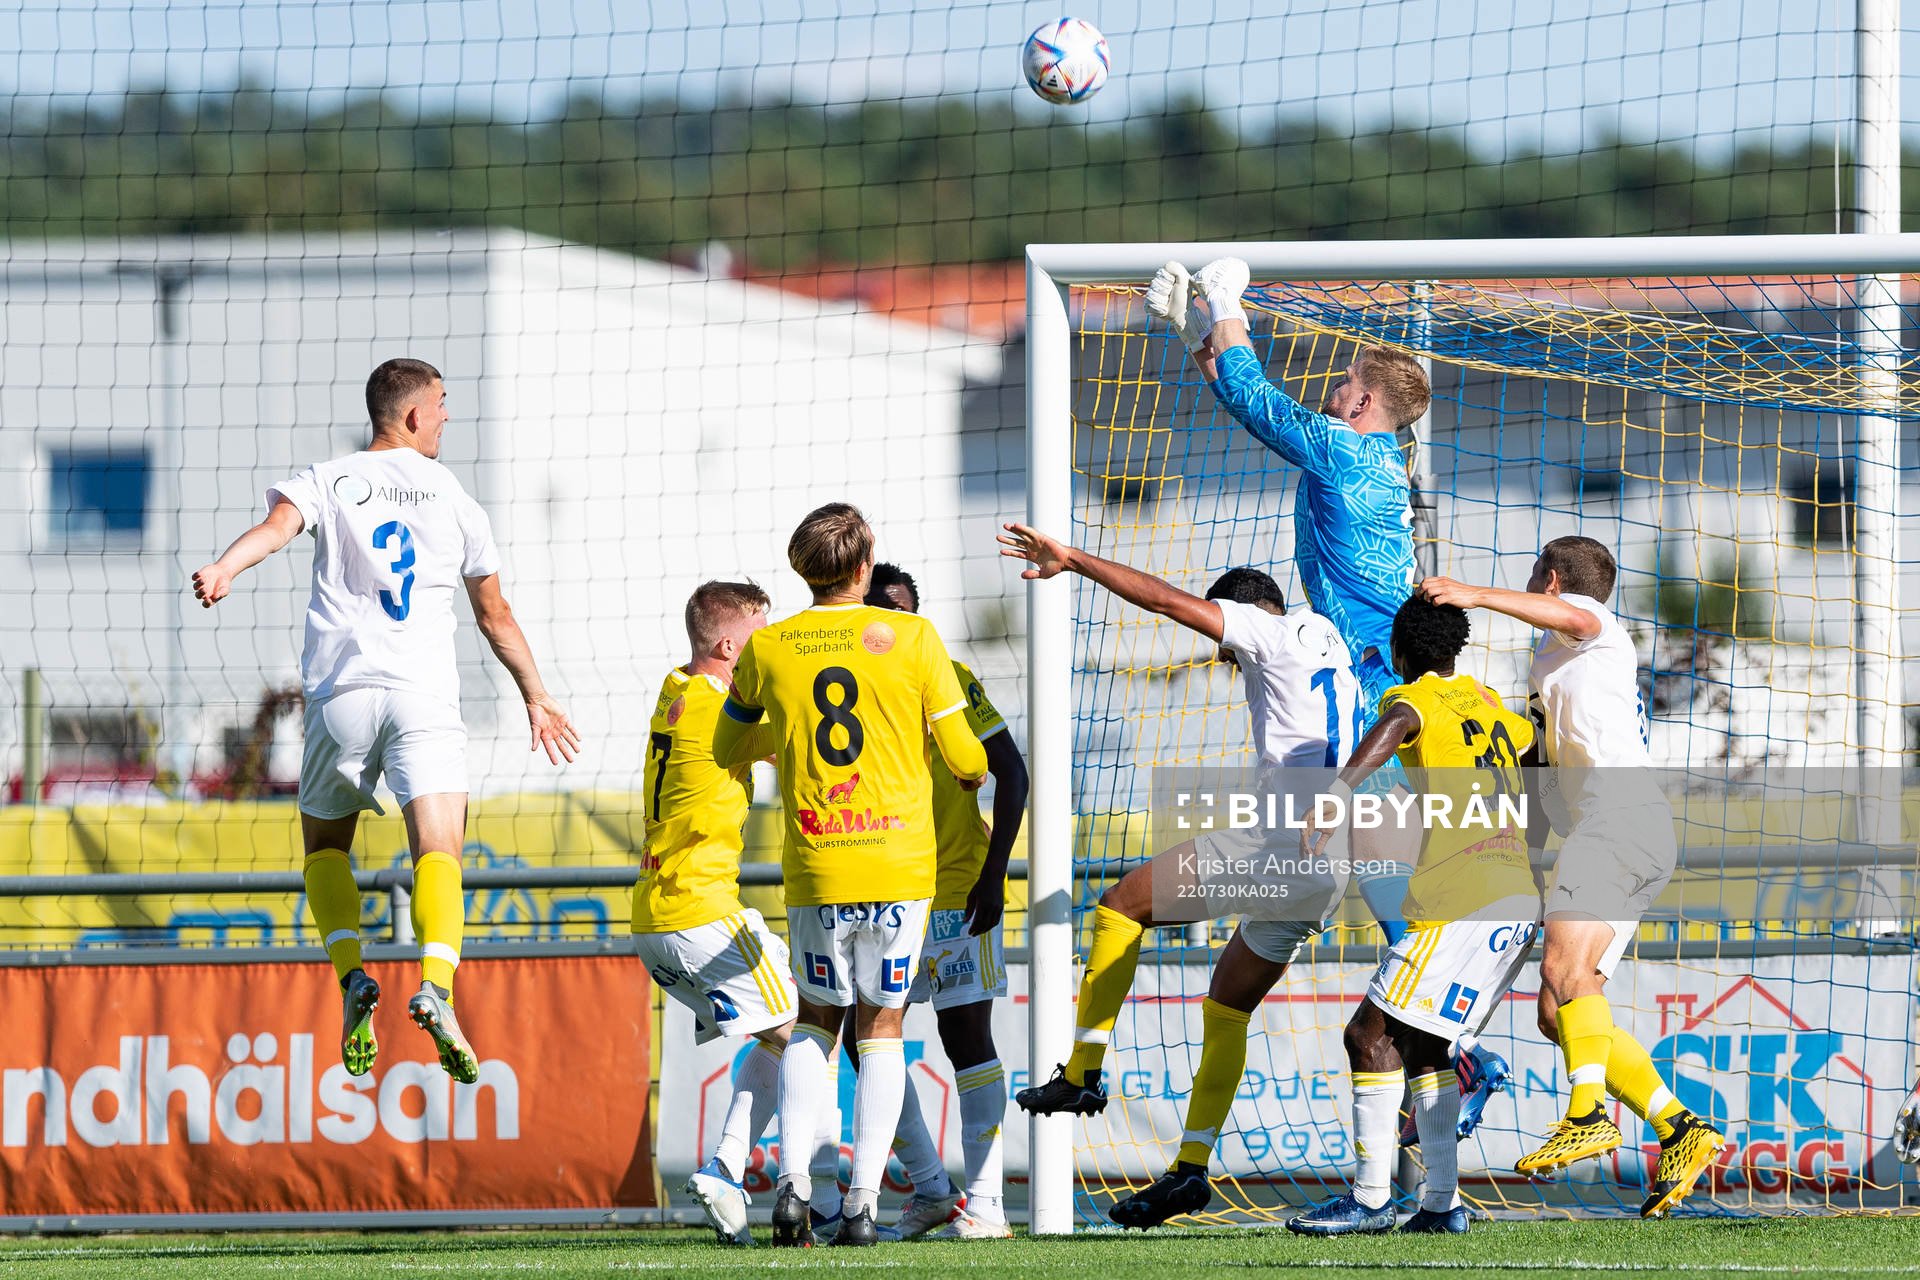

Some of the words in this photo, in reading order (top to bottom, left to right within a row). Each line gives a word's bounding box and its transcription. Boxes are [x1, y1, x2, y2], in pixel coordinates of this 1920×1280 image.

[376, 486, 436, 506] Allpipe
[372, 520, 416, 622] 3
[780, 628, 854, 642] Falkenbergs
[795, 641, 854, 656] Sparbank
[813, 666, 864, 767] 8
[1643, 1033, 1844, 1150] SK
